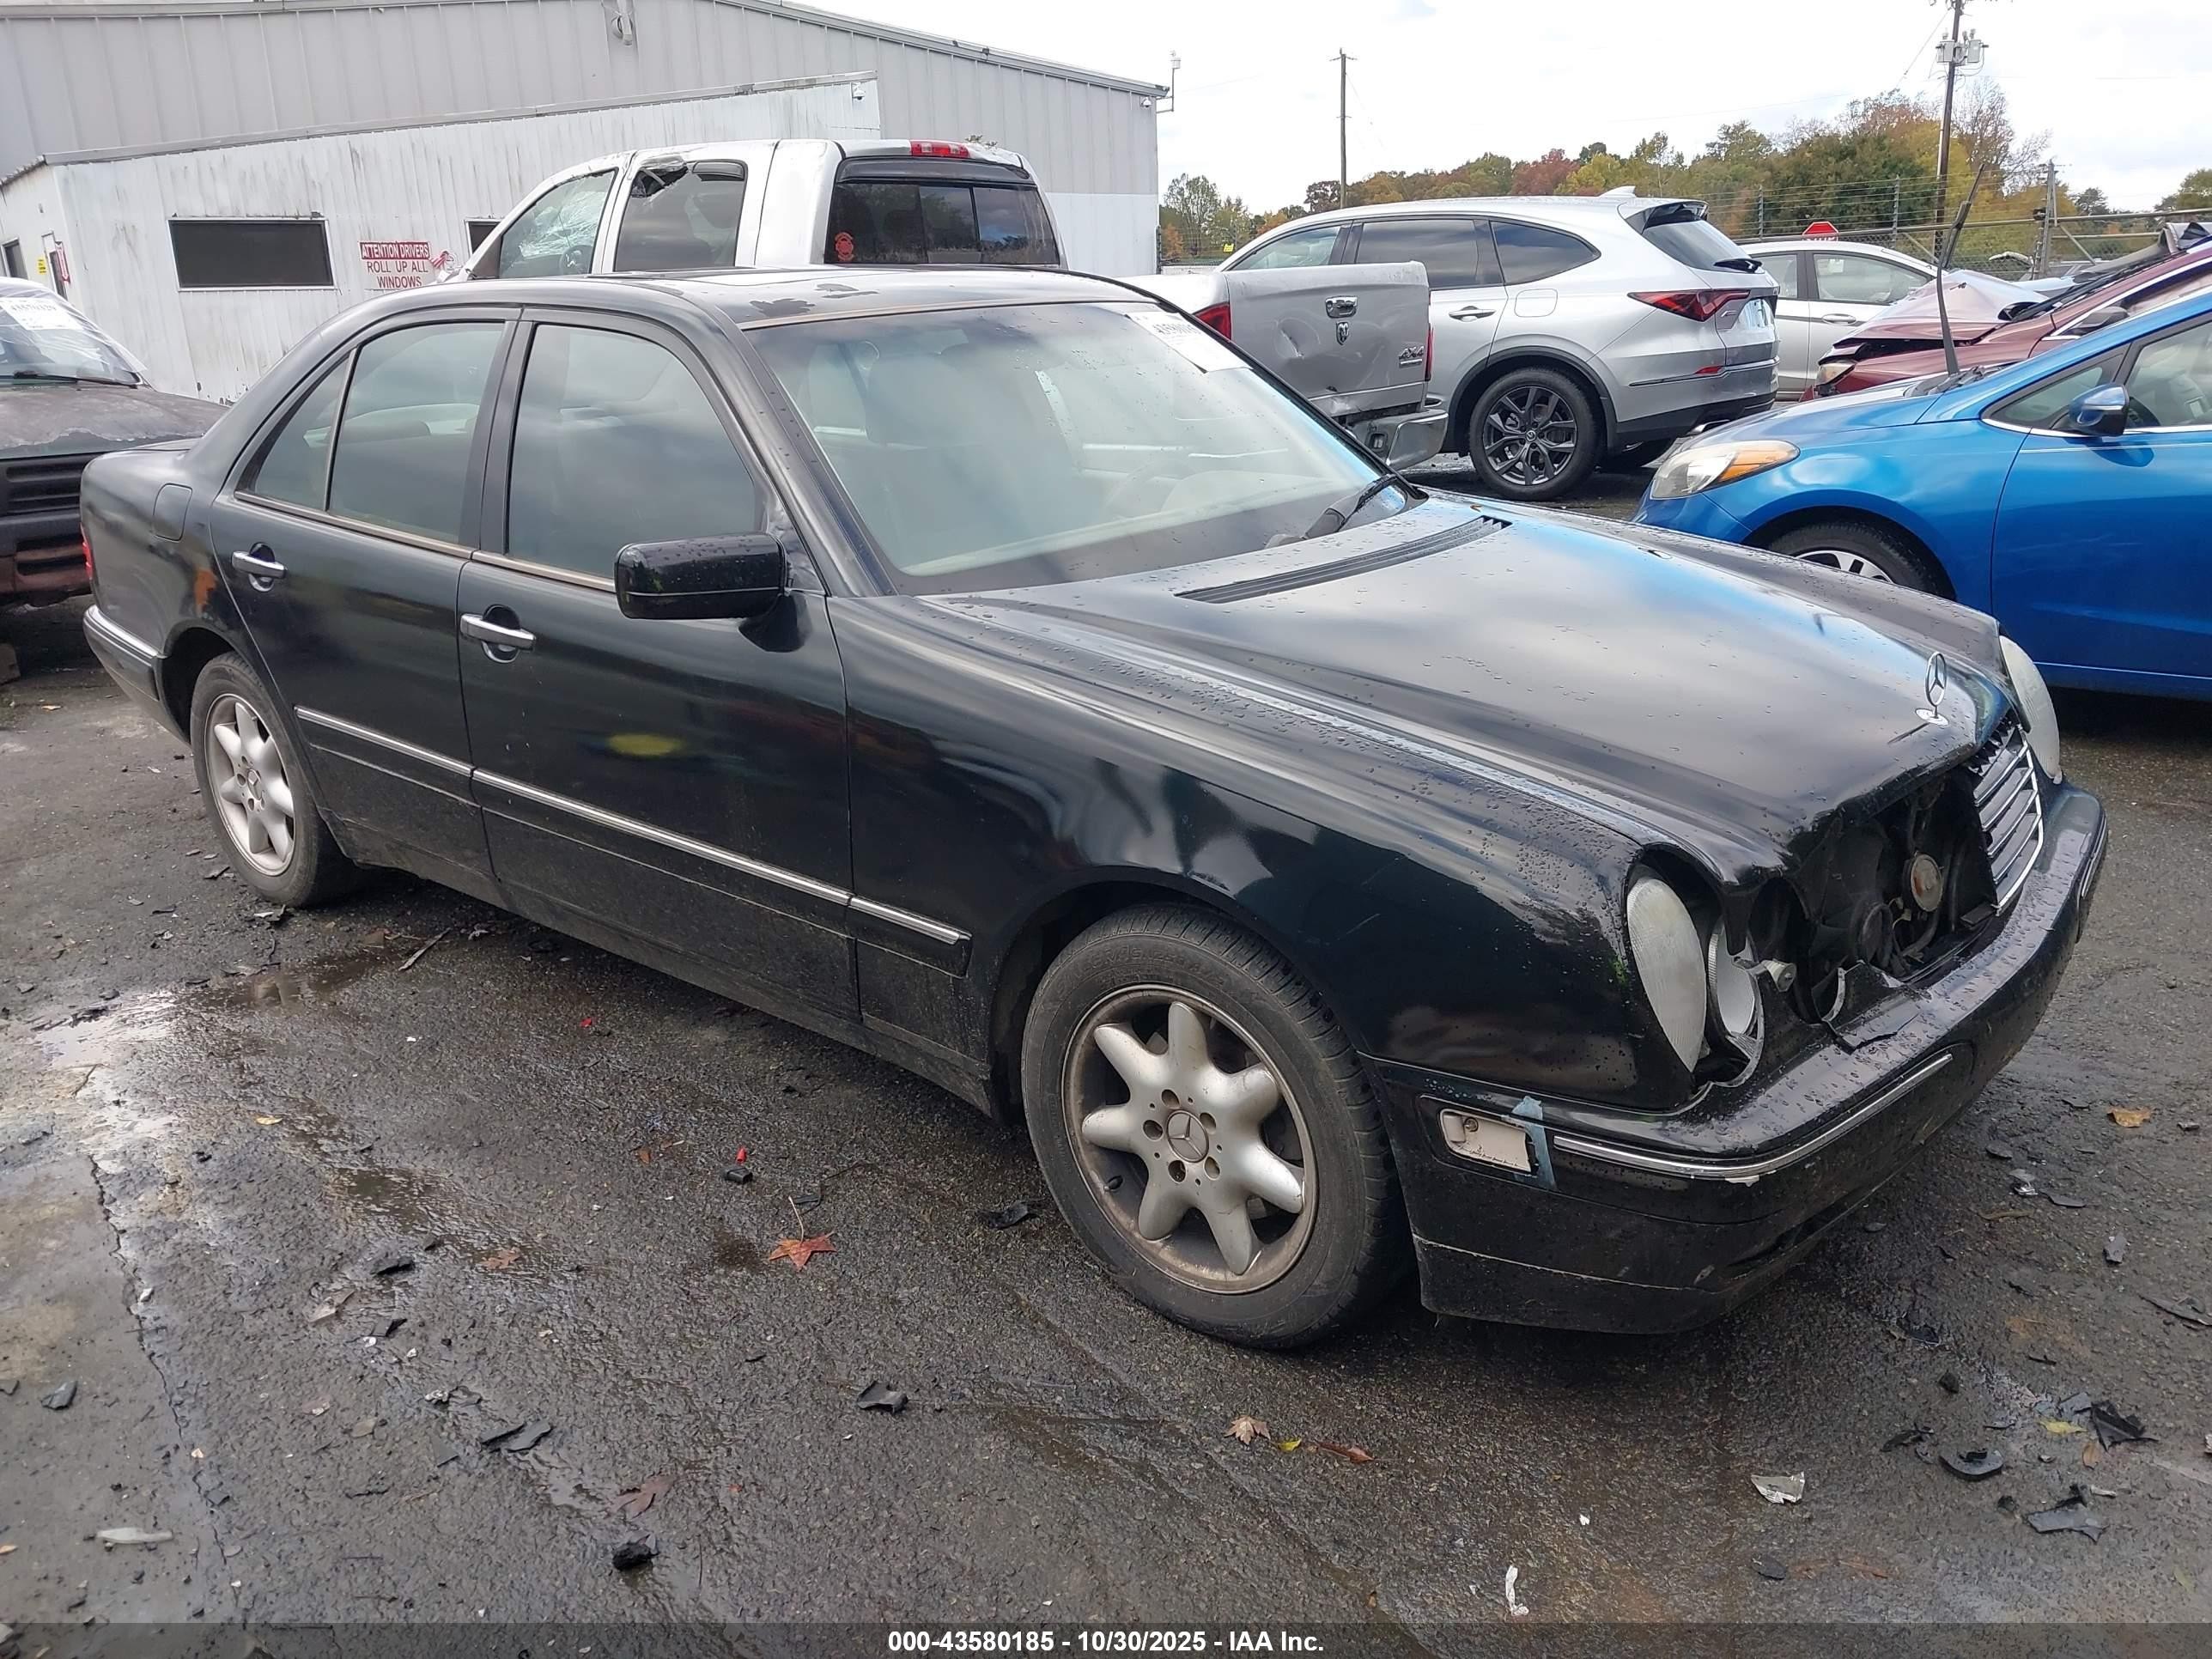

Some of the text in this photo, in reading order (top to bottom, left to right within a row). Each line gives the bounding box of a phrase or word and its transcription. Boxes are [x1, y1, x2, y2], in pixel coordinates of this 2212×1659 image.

[362, 243, 429, 258] ATTENTION DRIVERS
[367, 260, 428, 273] ROLL UP ALL
[376, 276, 422, 289] WINDOWS
